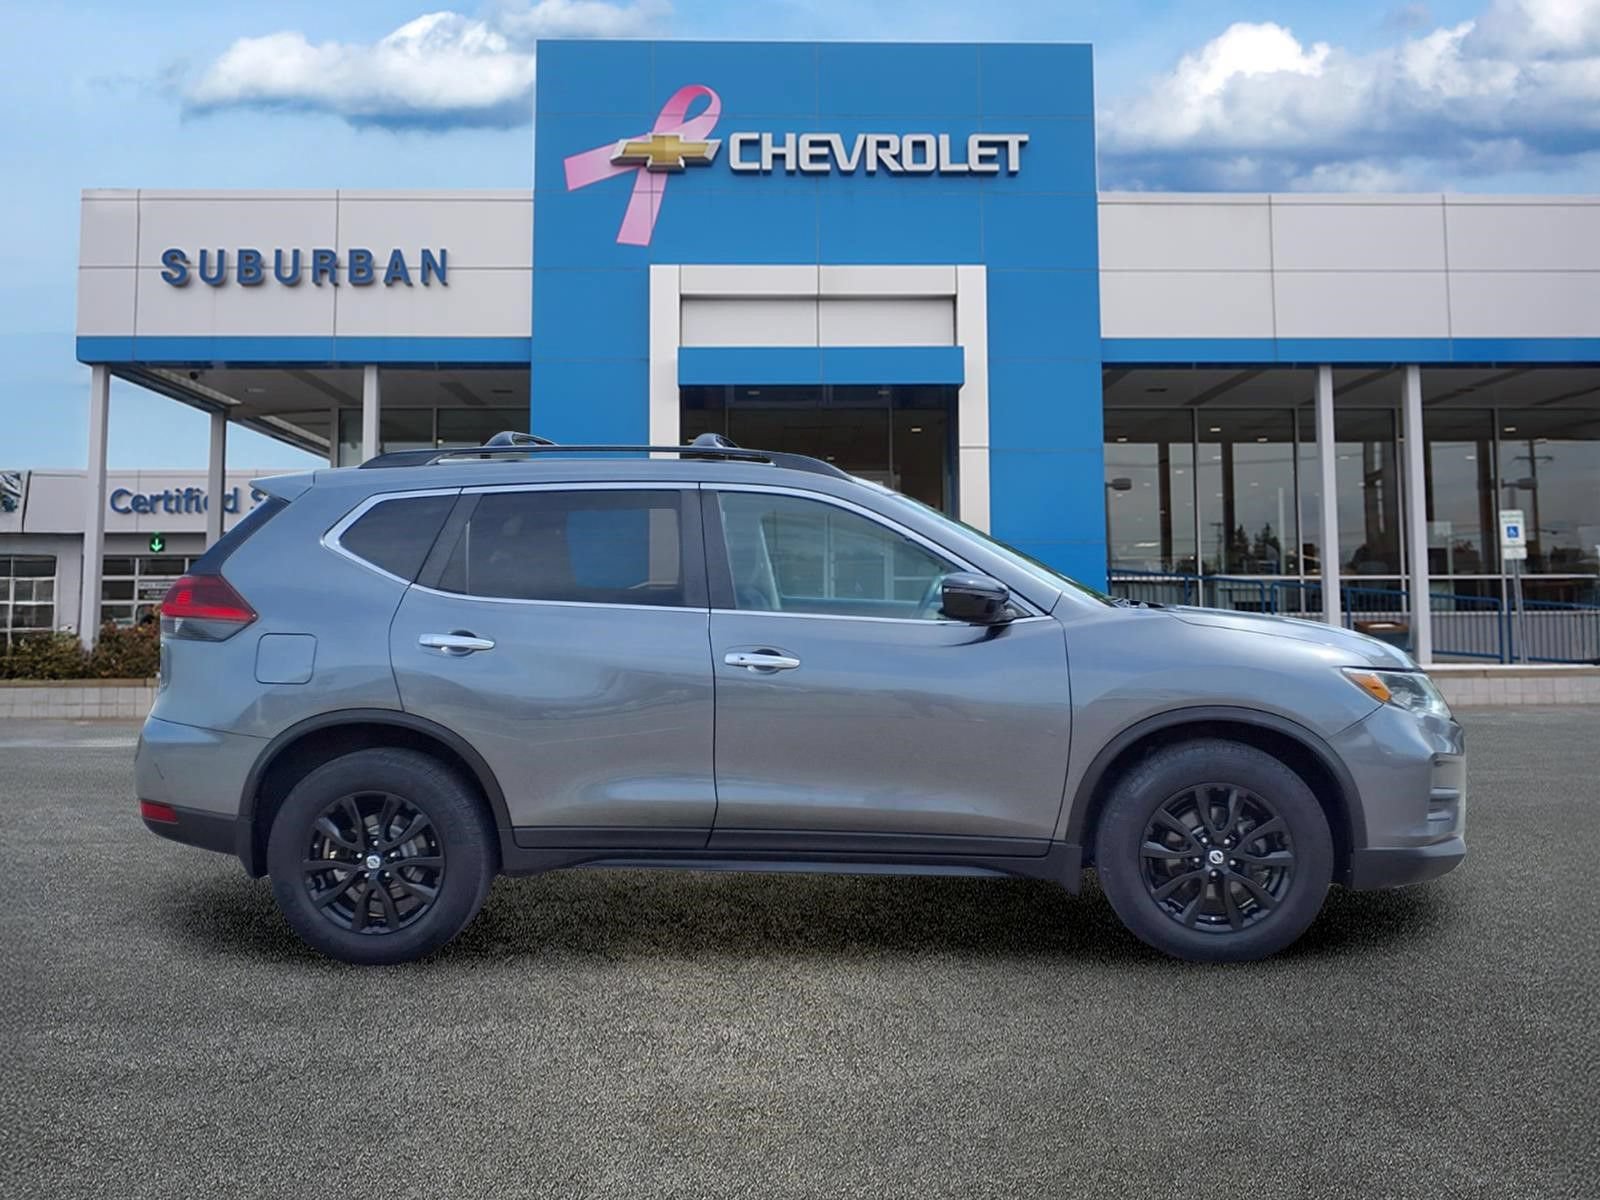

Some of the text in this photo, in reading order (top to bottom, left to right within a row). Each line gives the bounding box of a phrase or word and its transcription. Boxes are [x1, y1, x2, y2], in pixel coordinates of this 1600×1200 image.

[728, 131, 1029, 174] CHEVROLET
[161, 248, 449, 286] SUBURBAN
[110, 487, 240, 514] Certifid
